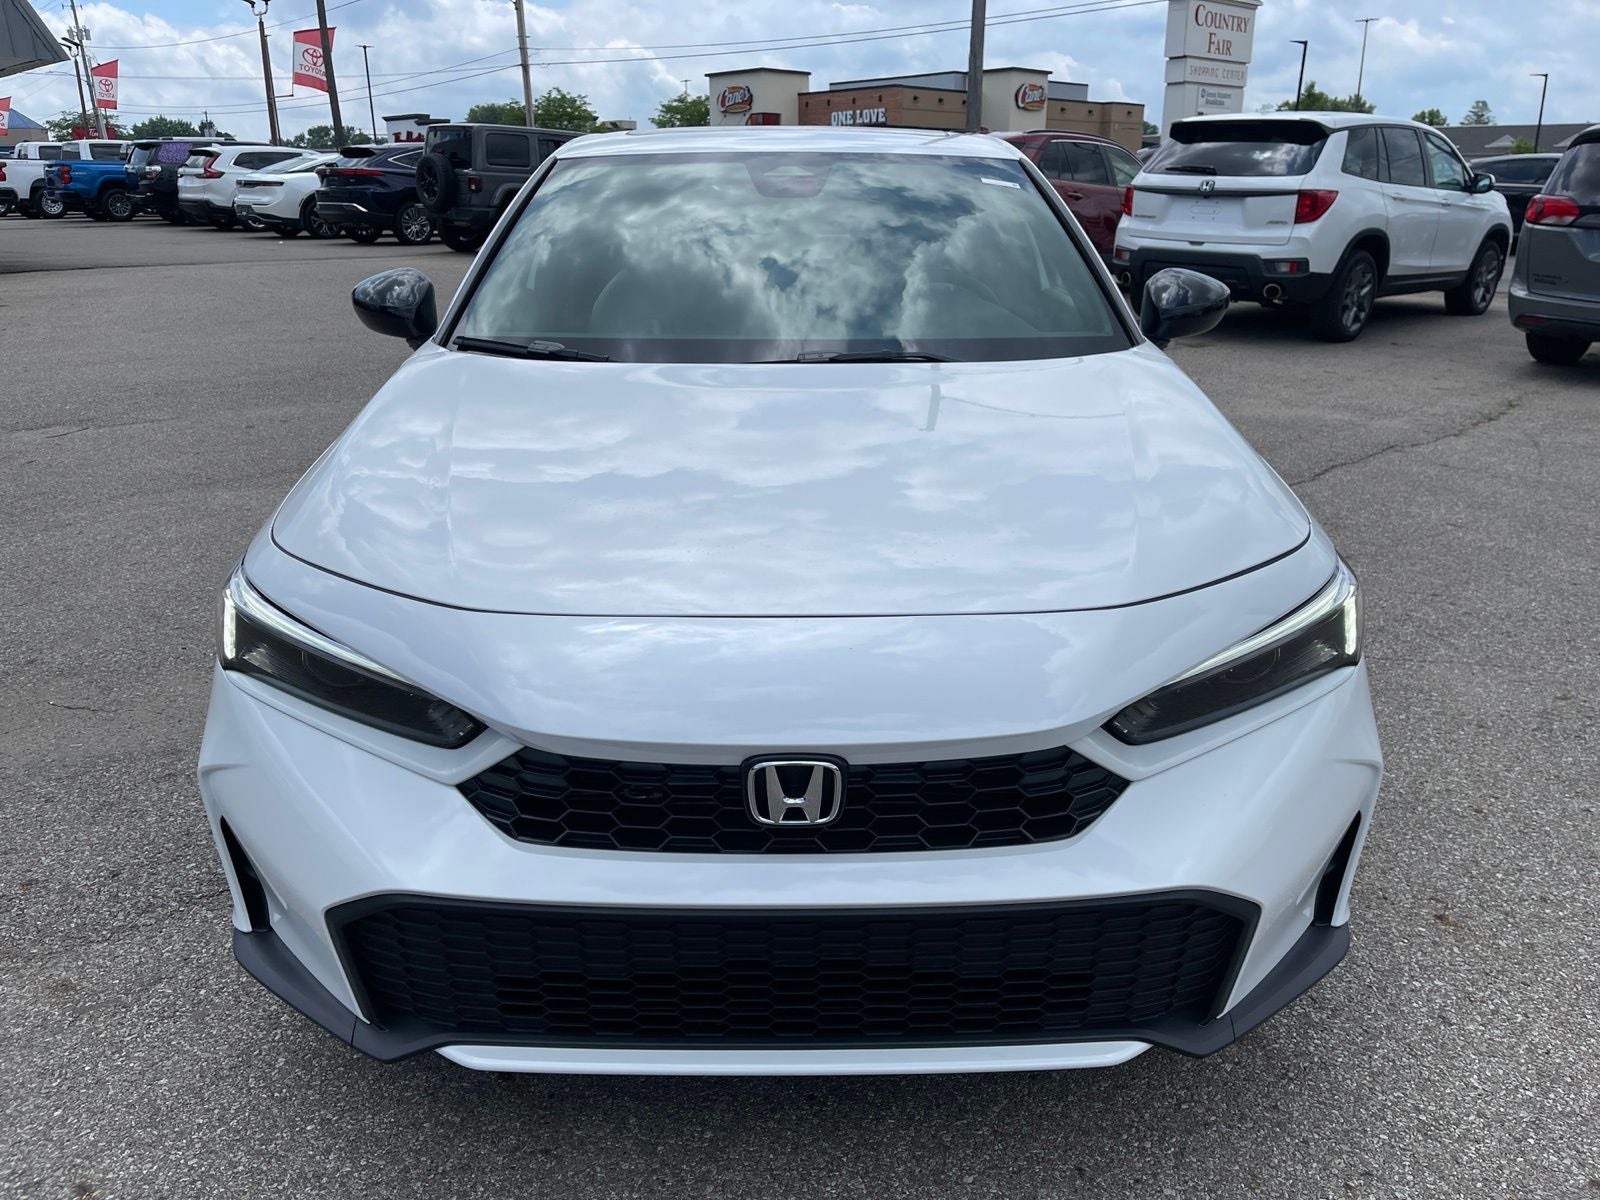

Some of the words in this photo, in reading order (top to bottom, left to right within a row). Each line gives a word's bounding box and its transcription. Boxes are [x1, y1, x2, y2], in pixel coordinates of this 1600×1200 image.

[1195, 4, 1250, 33] COUNTRY
[1207, 32, 1232, 56] FAIR
[299, 63, 326, 77] TOYOTA
[831, 111, 853, 126] ONE
[856, 107, 886, 124] LOVE
